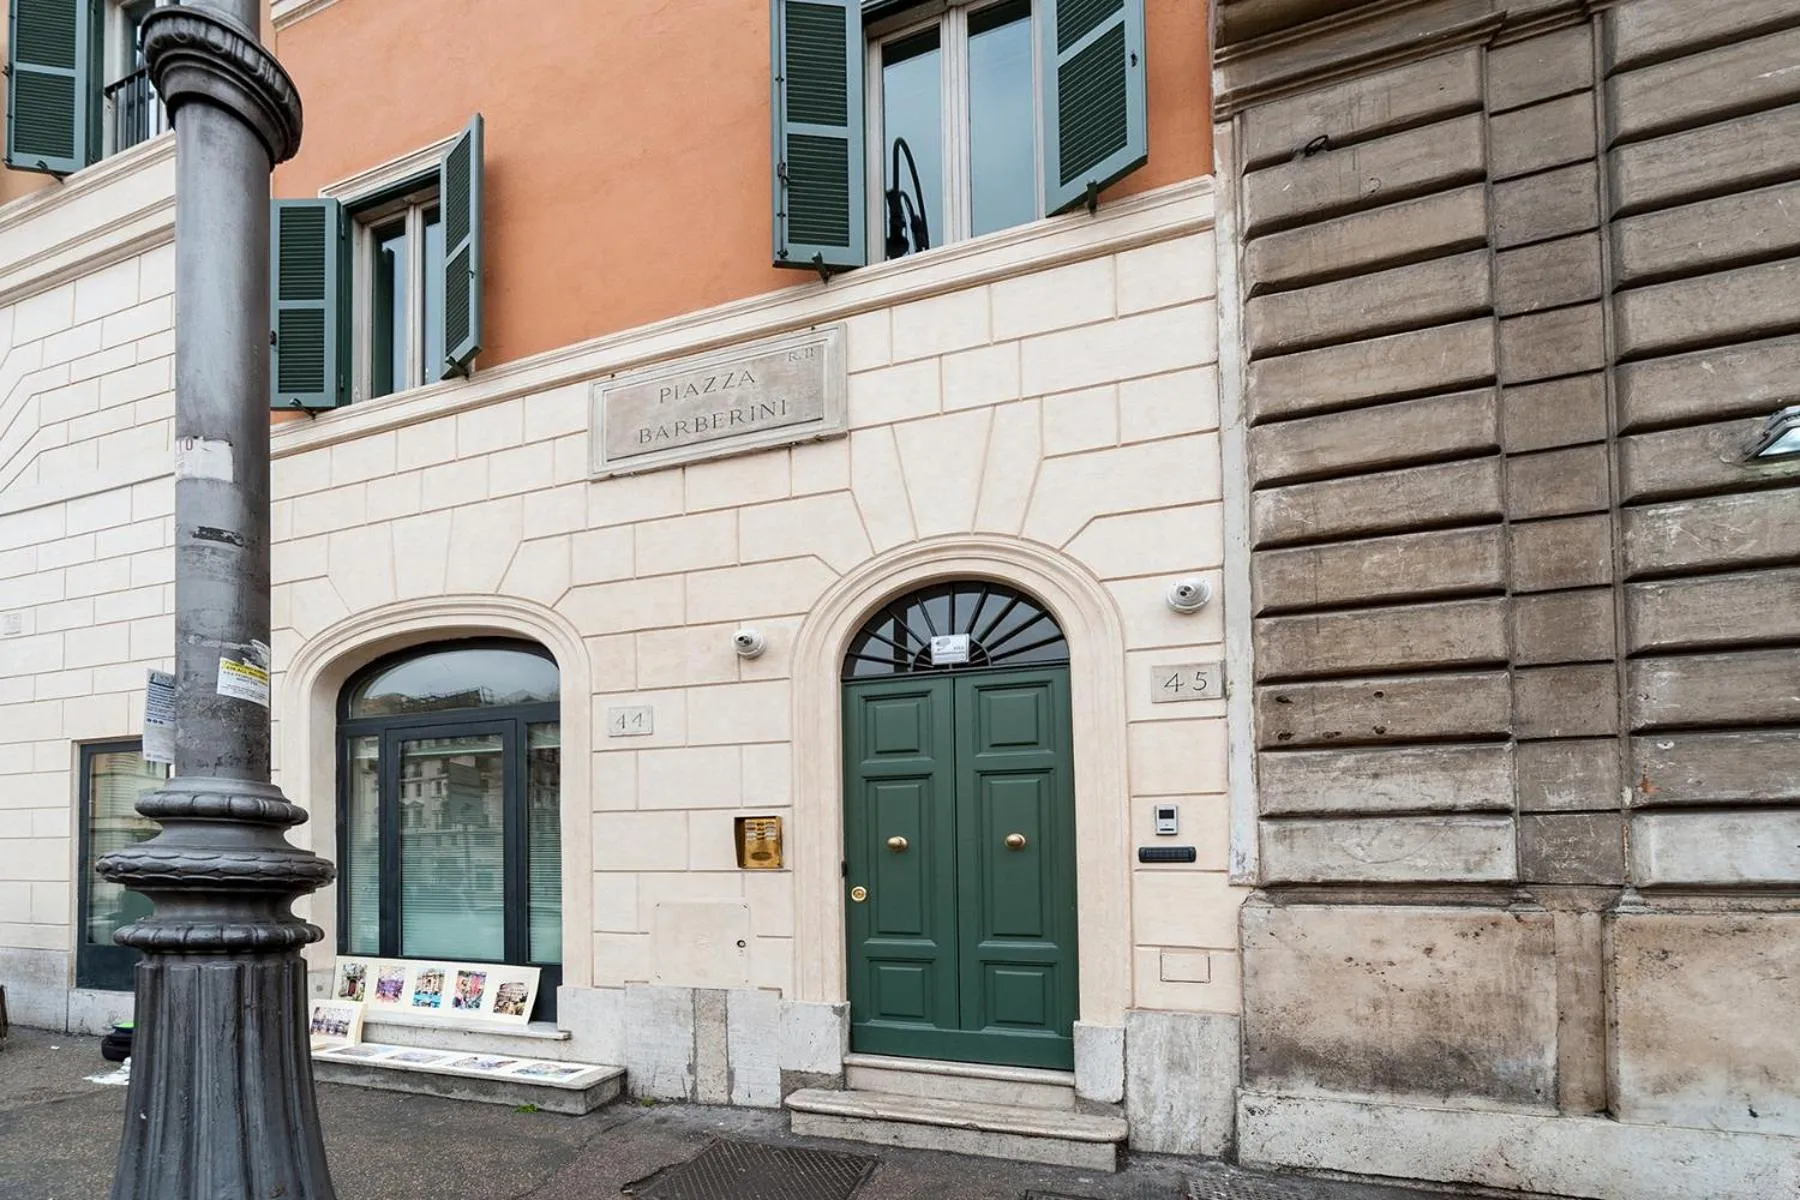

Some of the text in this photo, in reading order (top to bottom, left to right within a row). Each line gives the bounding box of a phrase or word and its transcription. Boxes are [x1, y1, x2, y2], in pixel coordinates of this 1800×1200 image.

[659, 370, 756, 404] PIAZZA
[639, 399, 787, 444] BARBERINI
[1164, 671, 1208, 692] 45
